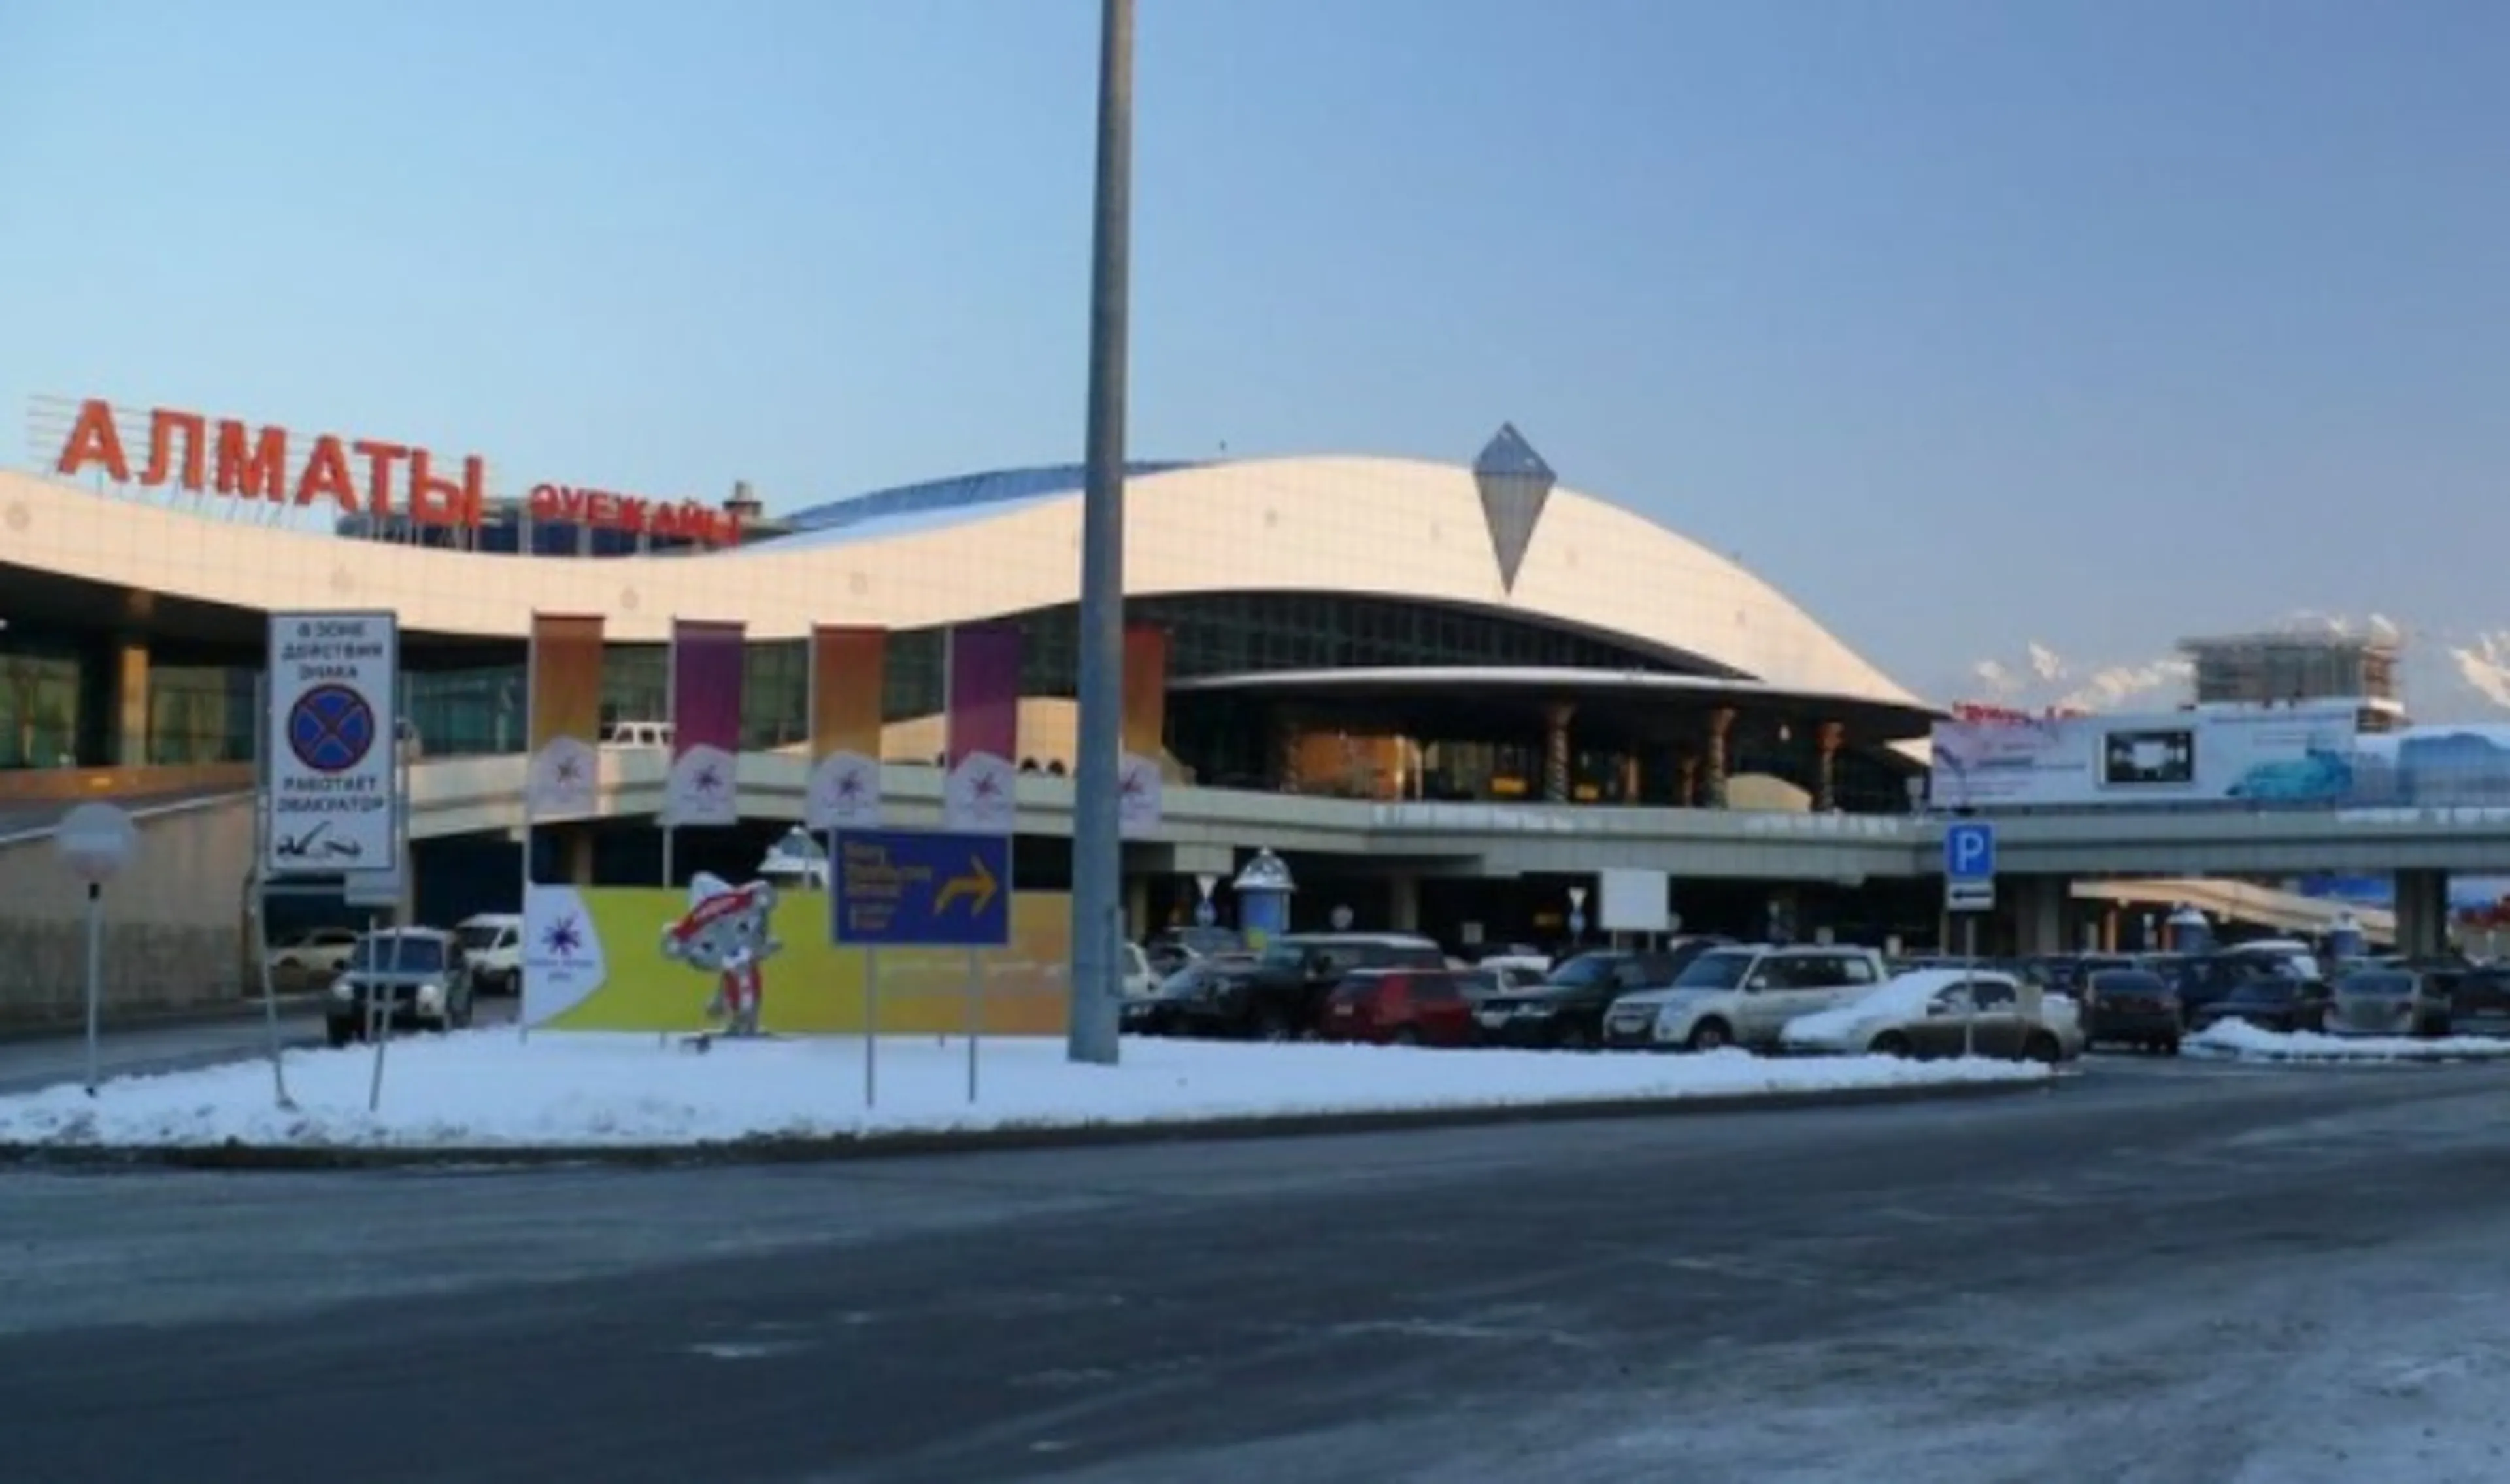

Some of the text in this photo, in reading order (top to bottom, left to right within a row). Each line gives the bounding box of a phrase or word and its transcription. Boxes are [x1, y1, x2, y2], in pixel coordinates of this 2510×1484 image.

[56, 397, 485, 529] АЛМАТЫ
[283, 776, 377, 793] РАБОТАЕТ
[1958, 832, 1984, 872] P
